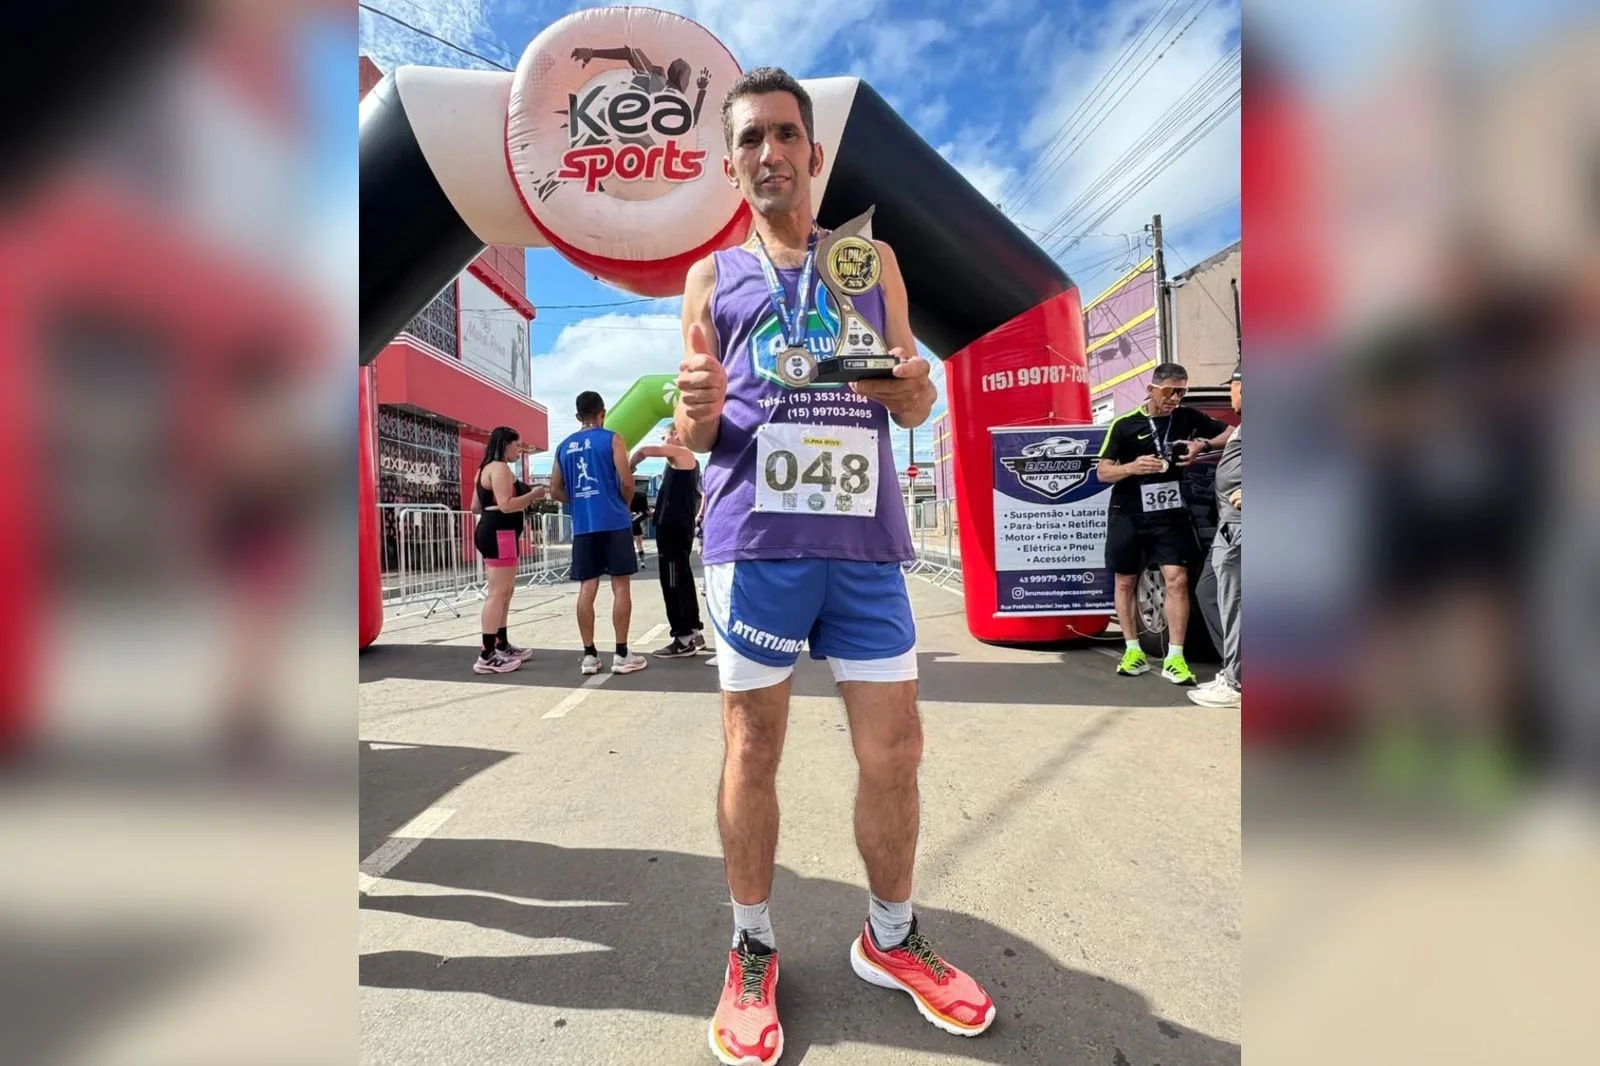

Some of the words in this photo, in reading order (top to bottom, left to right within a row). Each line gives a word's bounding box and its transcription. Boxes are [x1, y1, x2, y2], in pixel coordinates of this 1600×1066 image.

[558, 140, 706, 192] sports
[982, 370, 1014, 393] (15)
[789, 392, 811, 405] (15)
[814, 392, 868, 404] 3531-2184
[787, 408, 810, 420] (15)
[812, 407, 872, 419] 99703-2495
[765, 450, 870, 494] 048
[1025, 460, 1081, 472] BRUNO
[1145, 489, 1179, 505] 362
[1010, 510, 1063, 520] Suspensão
[1071, 508, 1106, 517] Lataria
[1010, 521, 1060, 530] Para-brisa
[1068, 519, 1107, 528] Retifica
[1043, 532, 1068, 540] Freio
[1023, 543, 1061, 552] Elétrica
[1069, 543, 1095, 551] Pneu
[1033, 554, 1086, 563] Acessórios
[1030, 574, 1083, 582] 99979-4759
